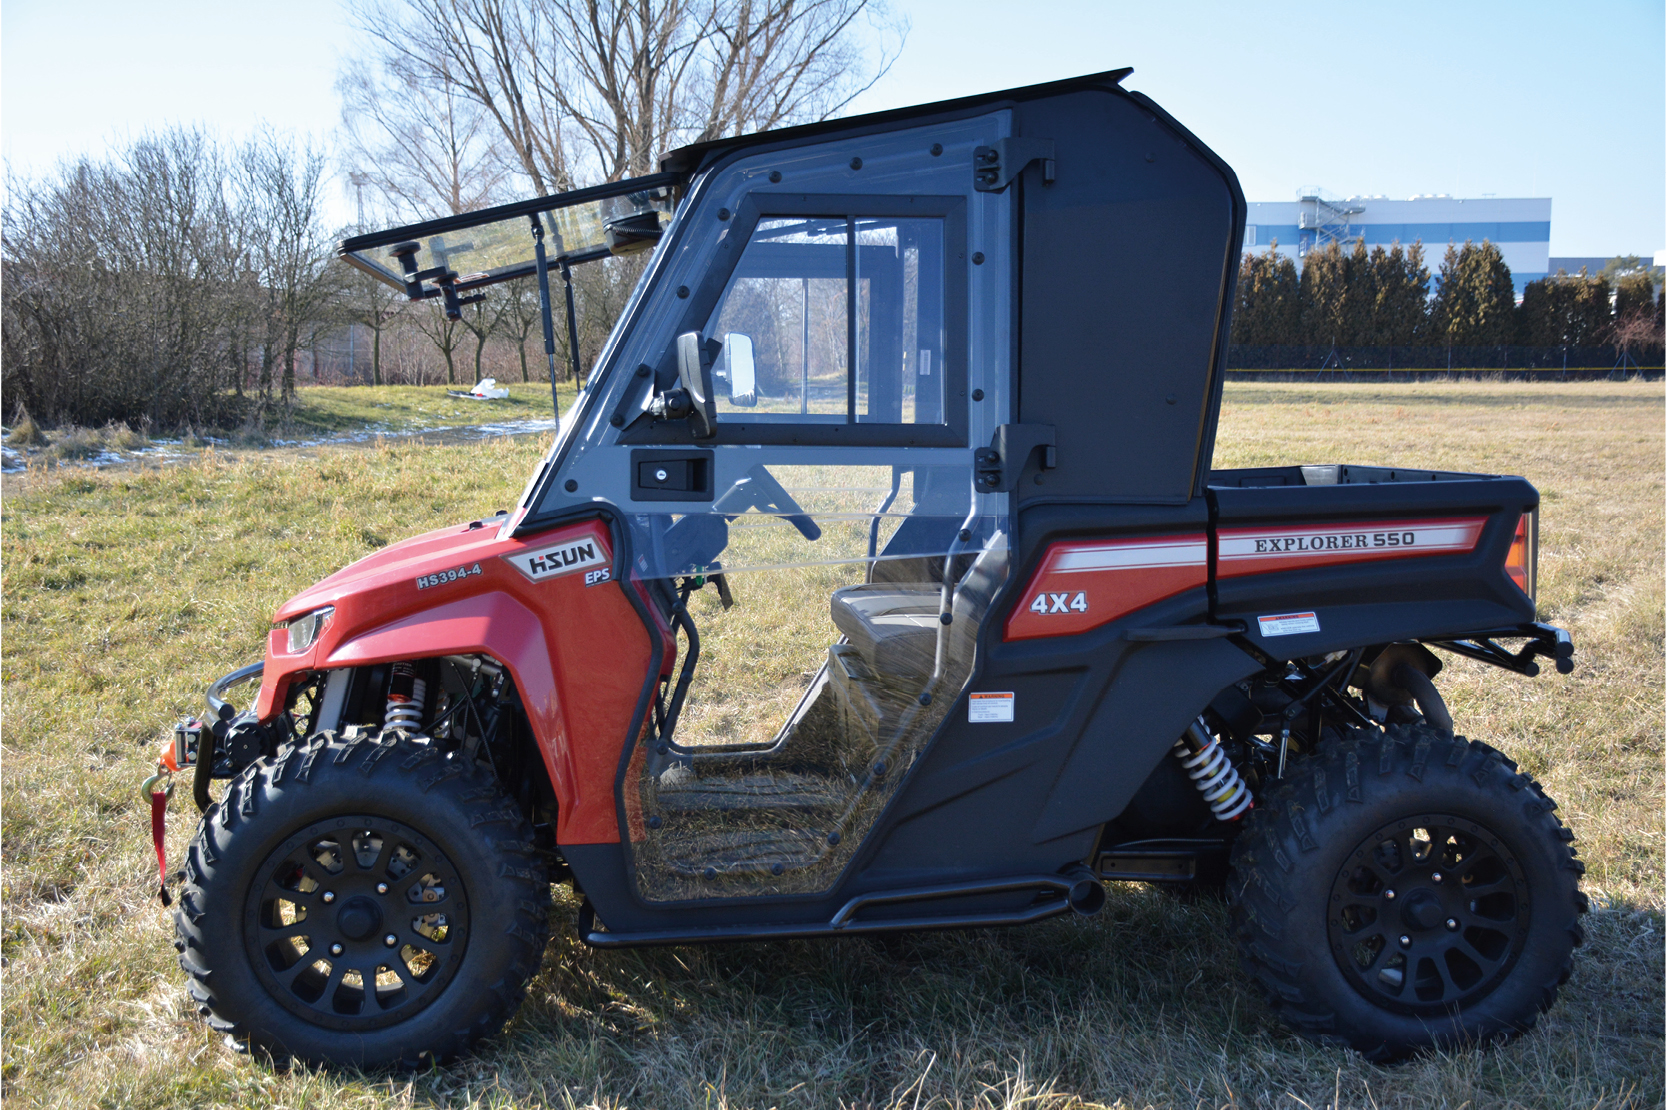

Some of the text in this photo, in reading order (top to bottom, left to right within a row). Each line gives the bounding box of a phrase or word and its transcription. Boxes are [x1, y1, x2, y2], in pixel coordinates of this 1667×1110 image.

[1255, 532, 1415, 552] EXPLORER 550
[529, 543, 596, 574] HSUN
[417, 563, 482, 589] HS394-4
[585, 568, 610, 585] EPS
[1030, 592, 1088, 614] 4X4
